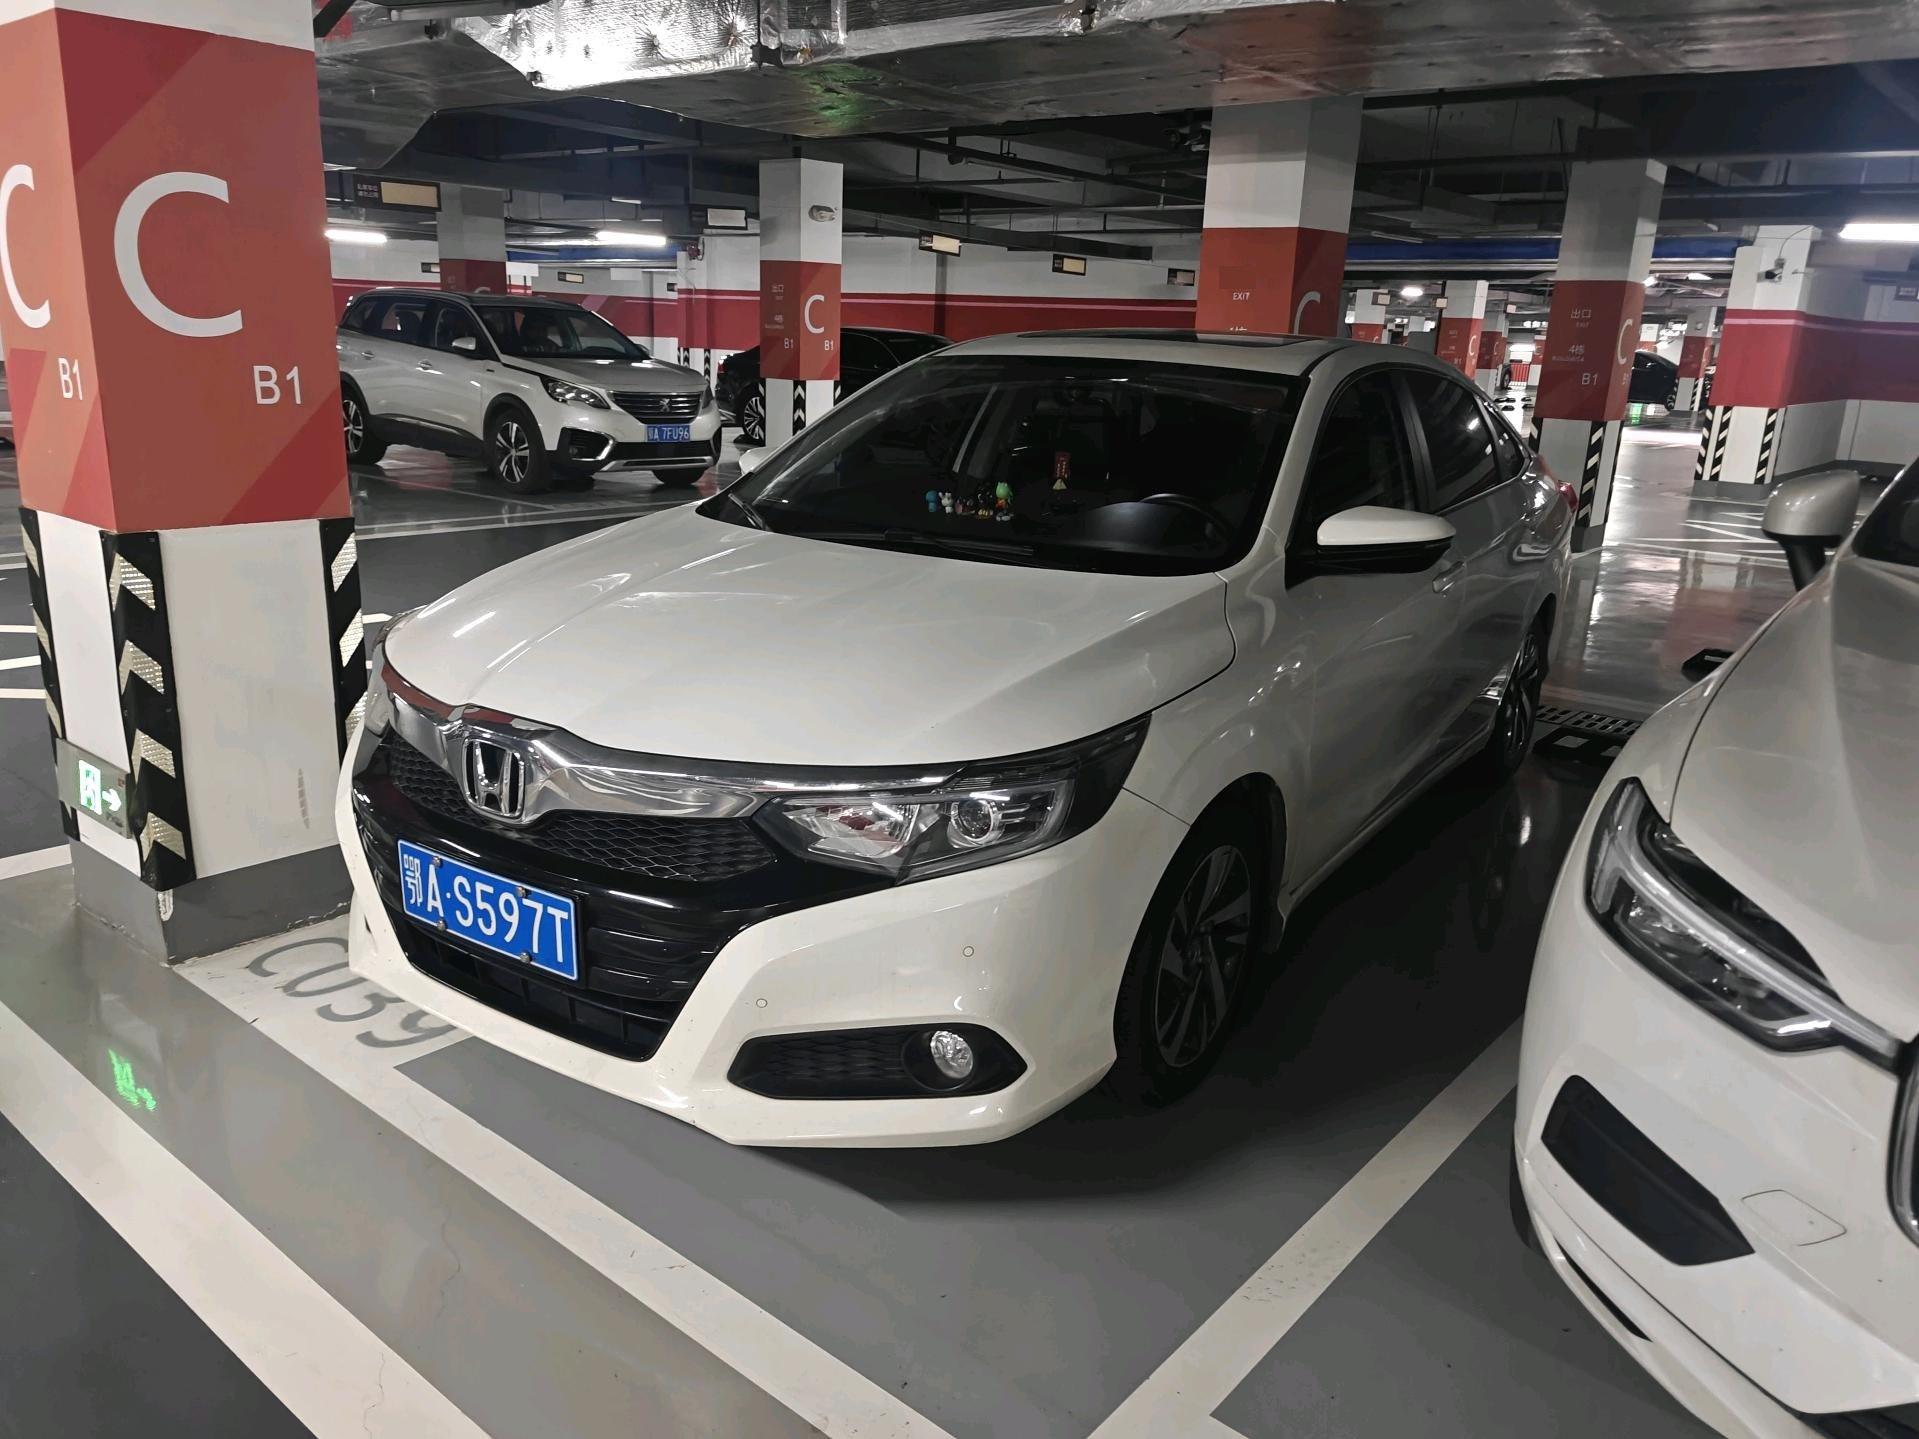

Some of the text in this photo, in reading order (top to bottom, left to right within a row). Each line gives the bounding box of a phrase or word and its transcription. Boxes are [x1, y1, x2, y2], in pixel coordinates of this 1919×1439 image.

[0, 164, 50, 328] C
[114, 171, 243, 337] C
[804, 294, 825, 334] C
[1233, 292, 1250, 300] EXIT
[1571, 308, 1592, 318] 出口
[824, 340, 833, 350] B1
[1469, 335, 1477, 356] C
[1618, 319, 1633, 365] C
[58, 357, 83, 400] B1
[253, 365, 302, 405] B1
[1582, 373, 1598, 385] B1
